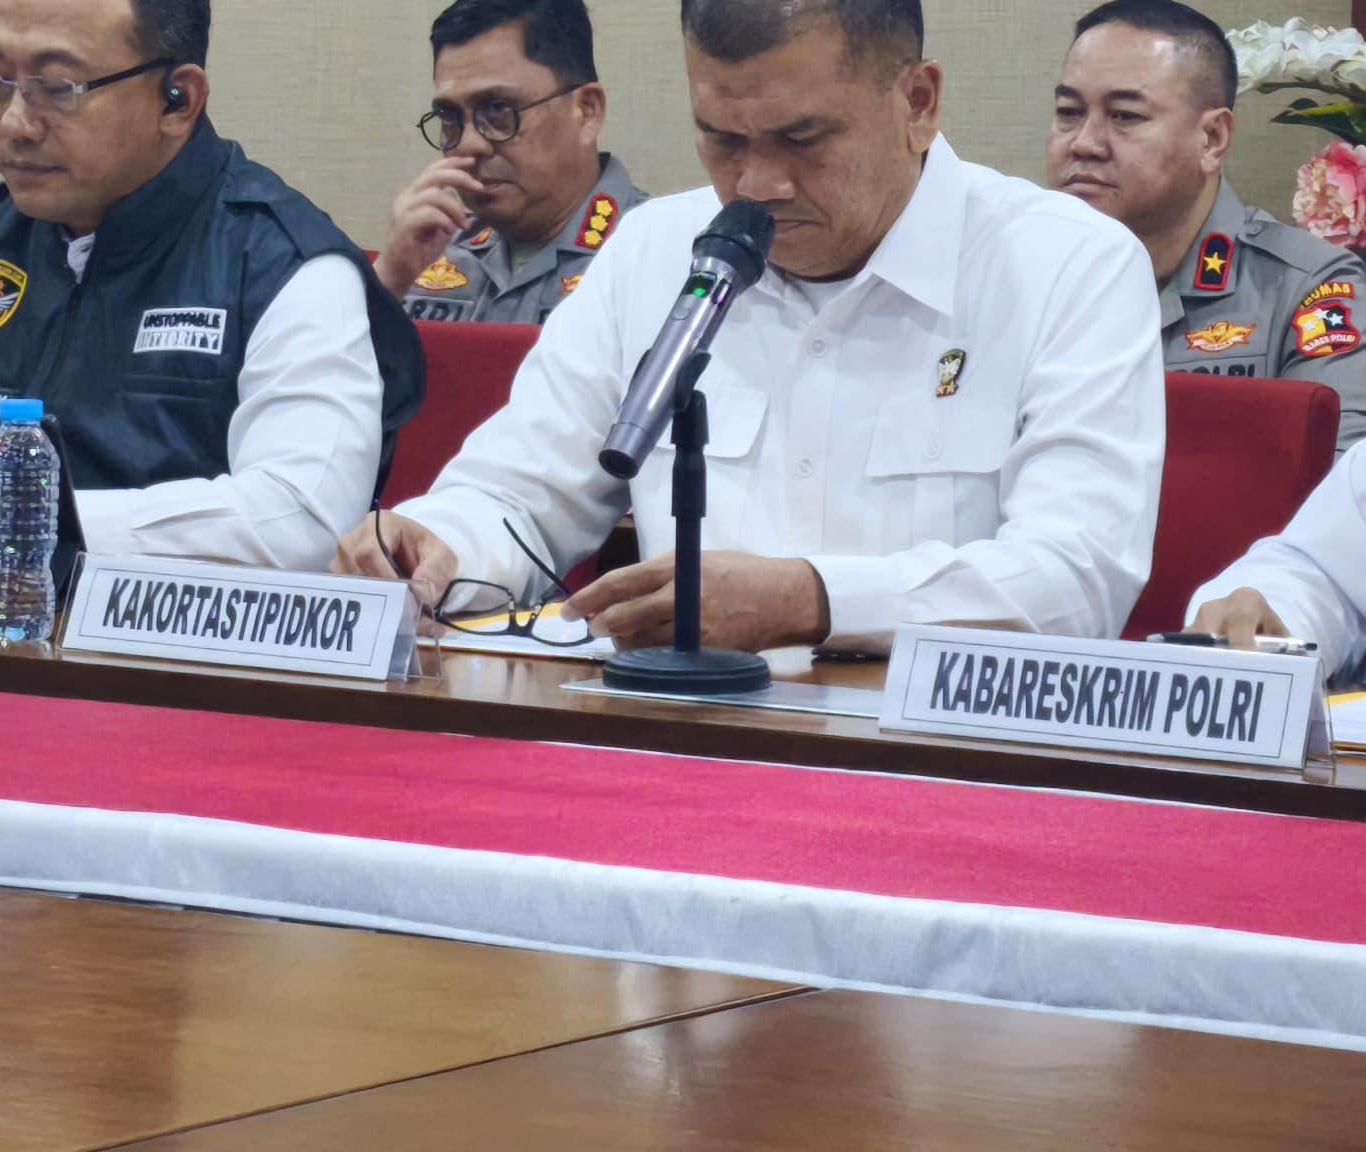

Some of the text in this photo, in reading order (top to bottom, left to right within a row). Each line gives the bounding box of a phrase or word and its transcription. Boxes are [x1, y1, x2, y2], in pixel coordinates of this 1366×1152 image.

[103, 577, 361, 651] KAKORTASTIPIDKOR
[930, 651, 1265, 742] KABARESKRIM POLRI
